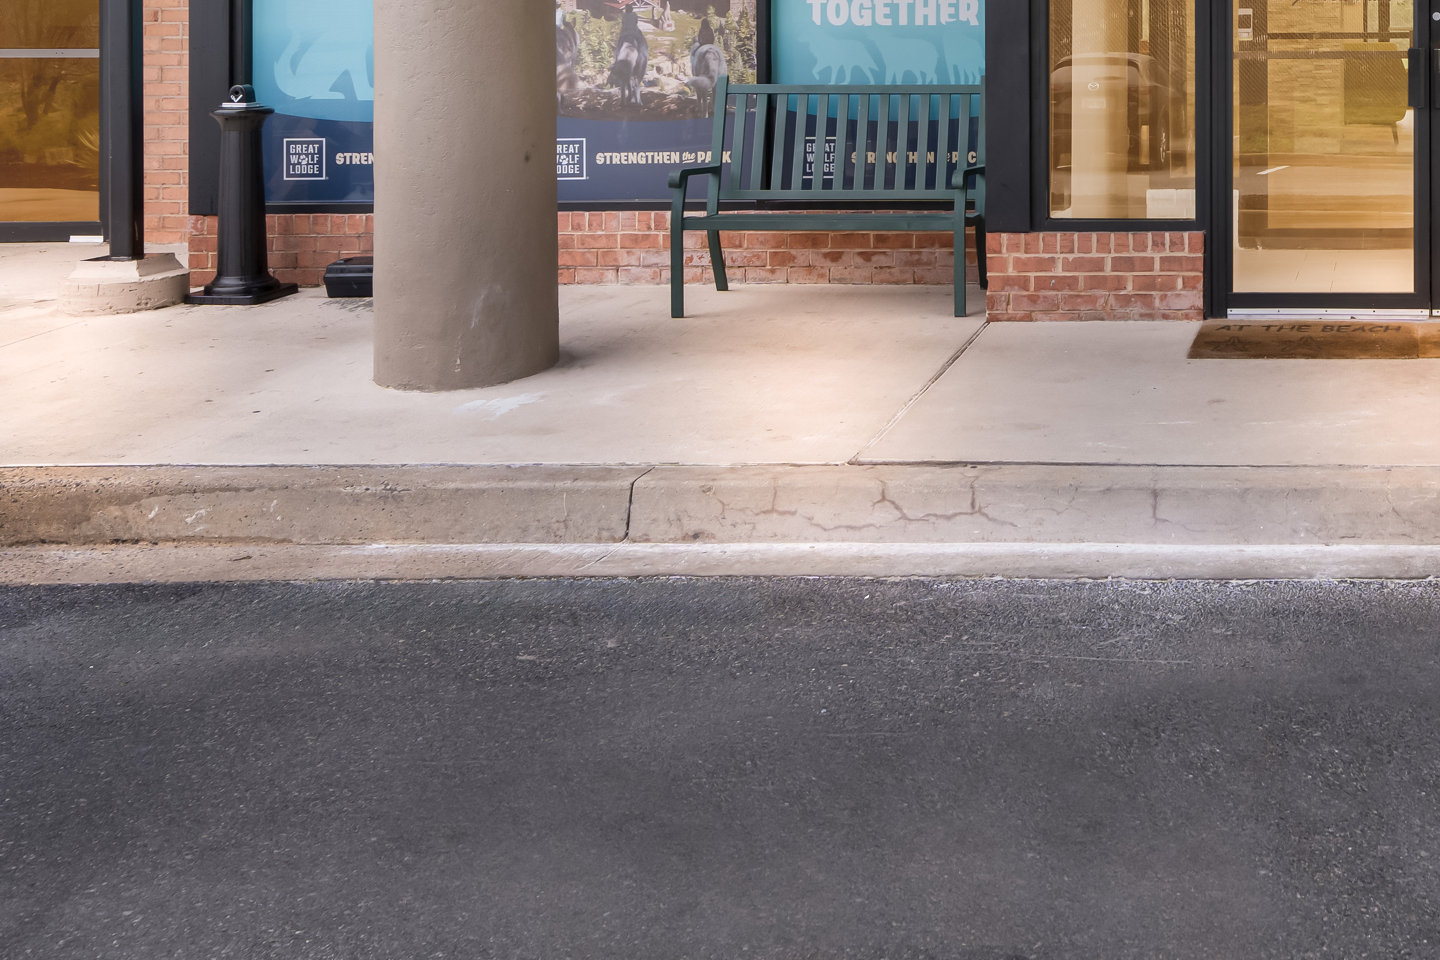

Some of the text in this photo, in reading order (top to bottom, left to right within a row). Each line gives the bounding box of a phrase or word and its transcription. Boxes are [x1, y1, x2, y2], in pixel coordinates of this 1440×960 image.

[289, 144, 320, 154] GREAT
[556, 144, 580, 154] REAT
[595, 150, 732, 165] STRENGTHEN the PAK
[289, 164, 320, 175] LODGE
[556, 164, 580, 174] ODGE
[1262, 324, 1311, 333] THE
[1320, 324, 1402, 333] BEACH
